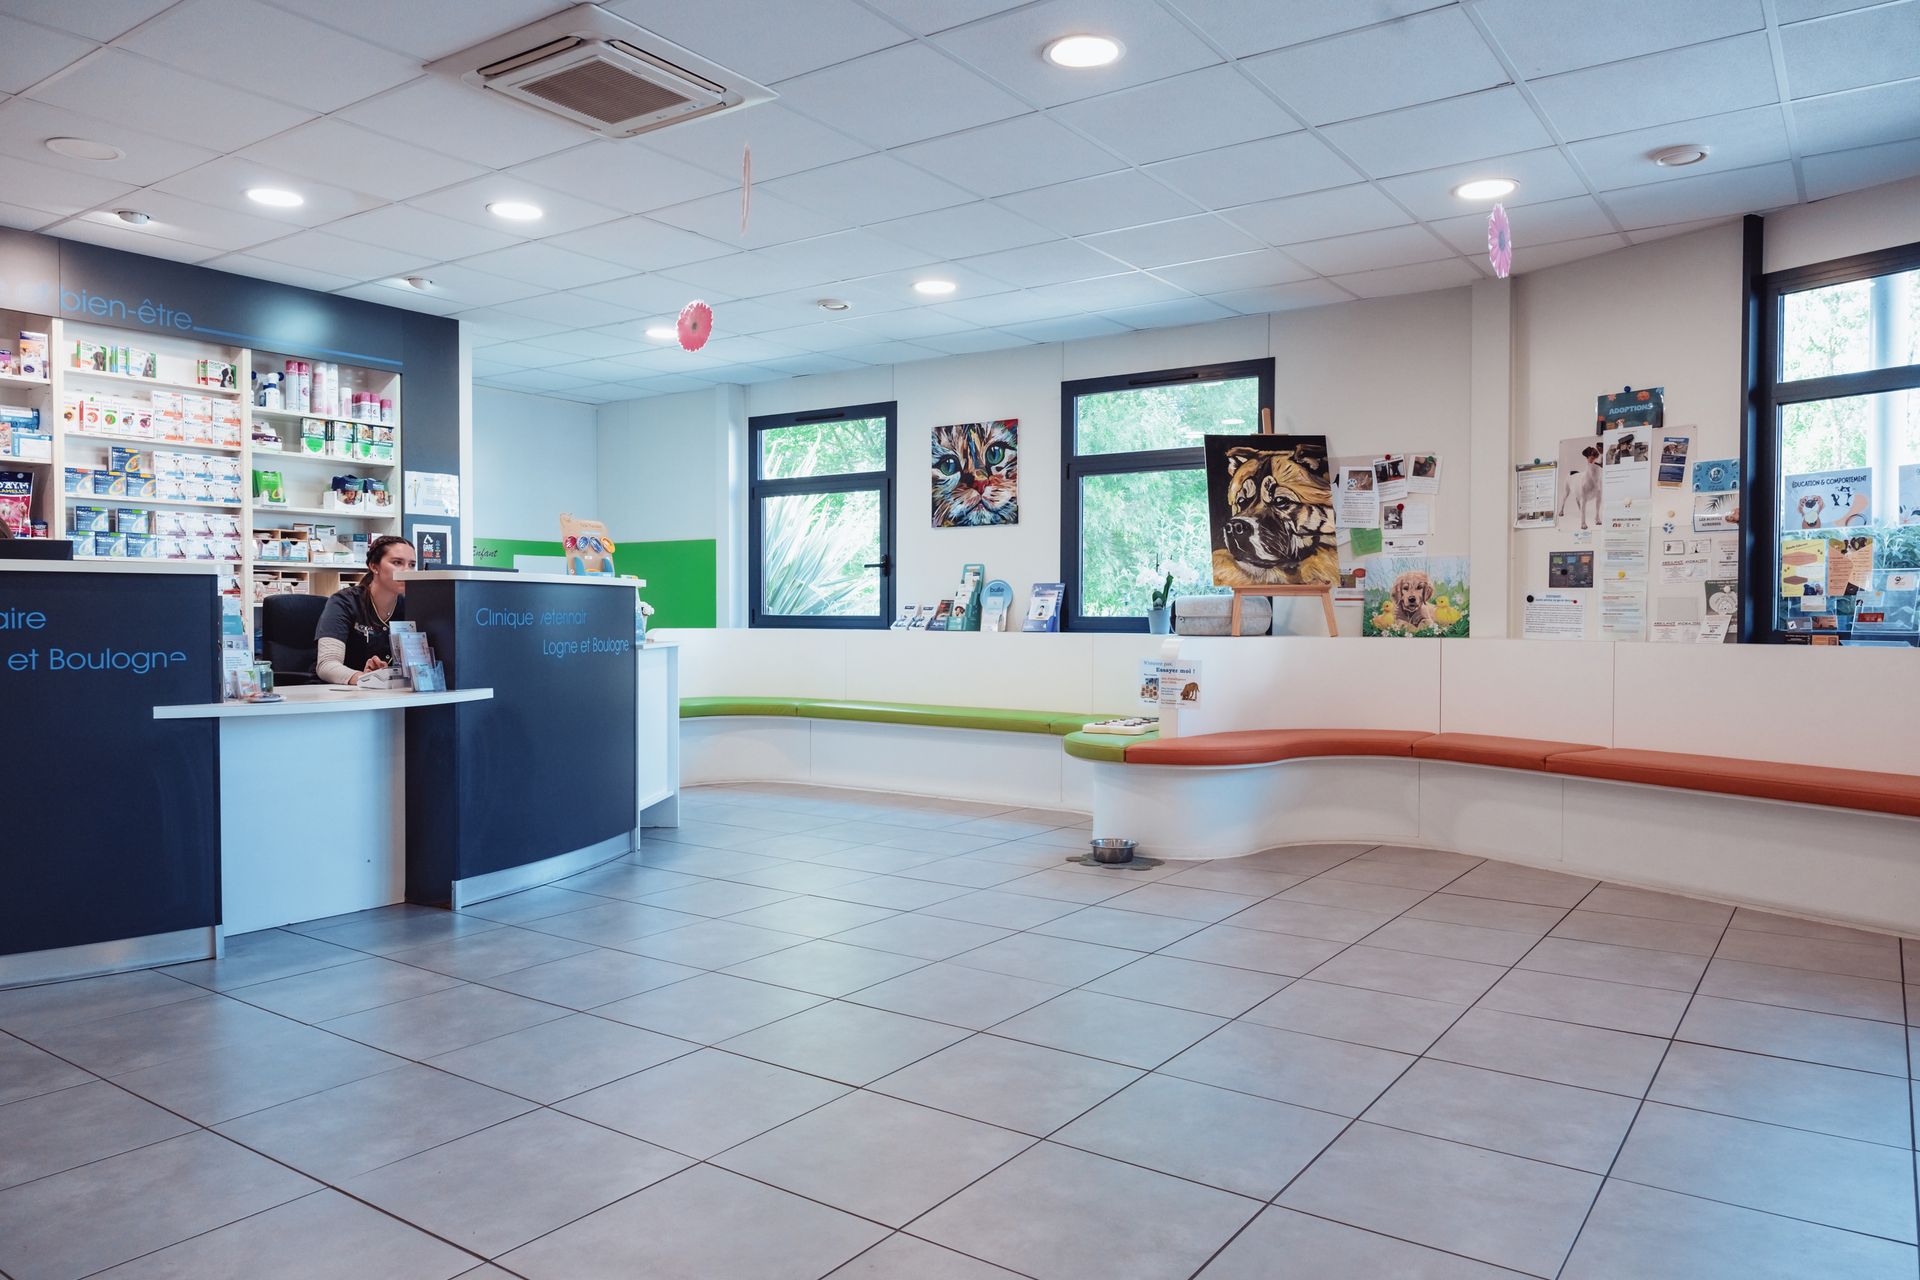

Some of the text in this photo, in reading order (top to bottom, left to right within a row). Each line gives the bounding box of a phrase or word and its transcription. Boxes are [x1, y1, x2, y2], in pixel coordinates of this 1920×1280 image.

[61, 286, 192, 330] bien-être
[1609, 403, 1653, 415] ADOPTIONS
[1792, 475, 1867, 489] ÉDUCATION & COMPORTEMENT
[476, 608, 534, 630] Clinique
[543, 637, 629, 658] Logne et Boulogne
[8, 649, 39, 671] et
